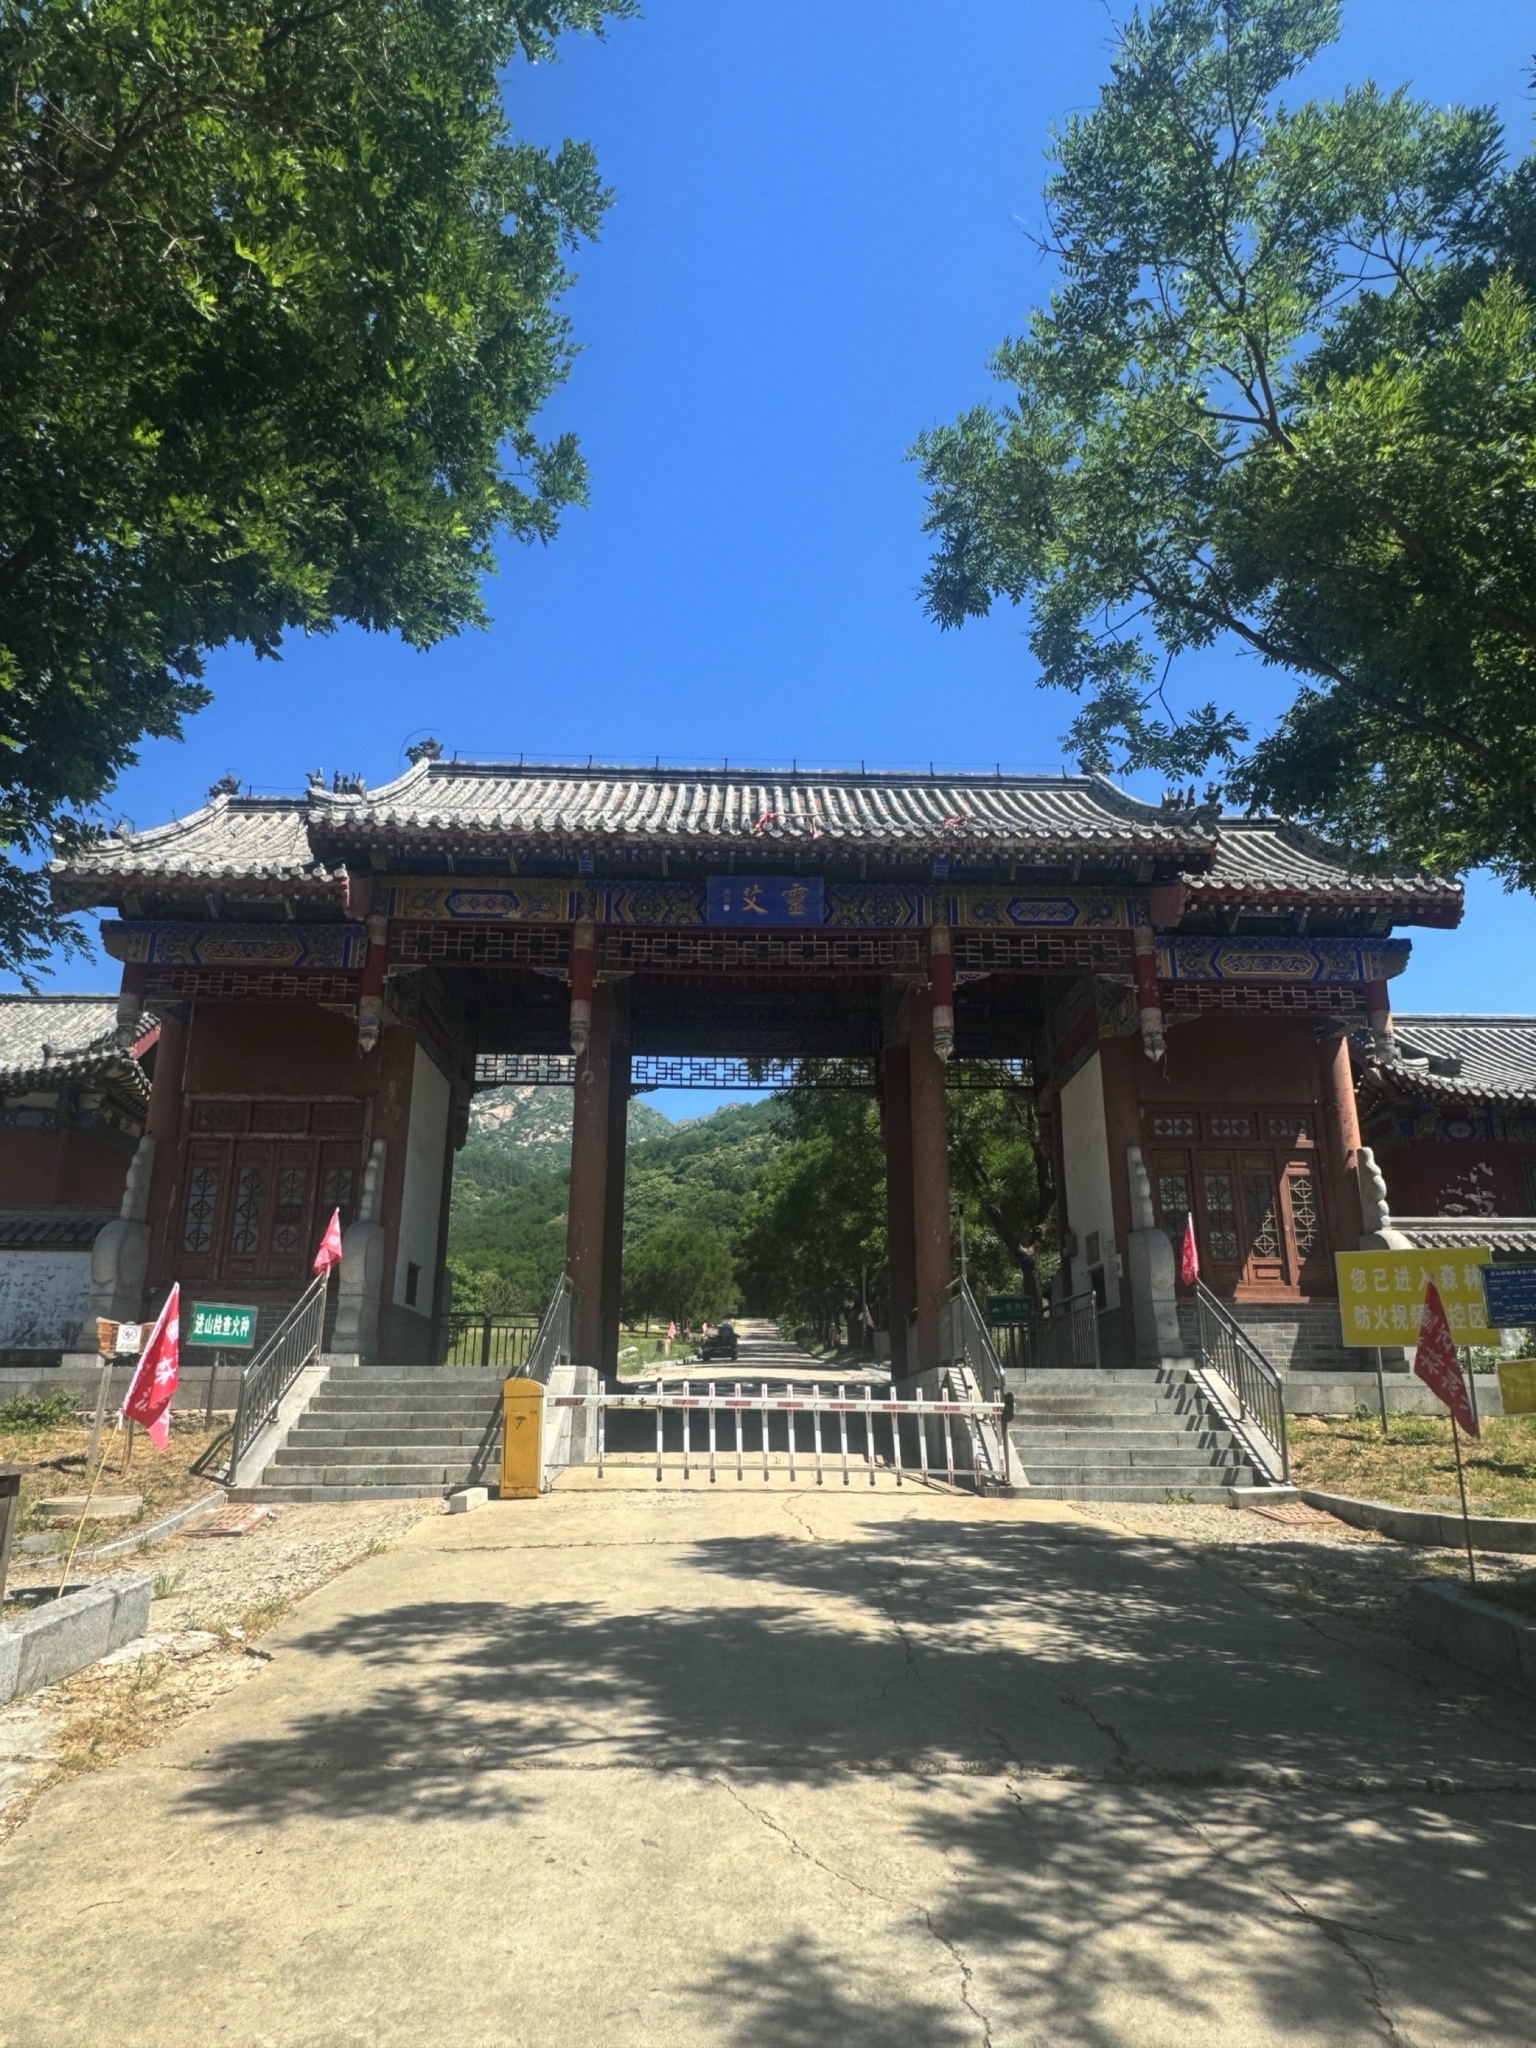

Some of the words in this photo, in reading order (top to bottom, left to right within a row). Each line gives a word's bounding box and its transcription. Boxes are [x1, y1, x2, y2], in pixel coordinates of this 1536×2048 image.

[1351, 1263, 1481, 1292] 您已进入森林
[1354, 1303, 1487, 1330] 防火视频控区
